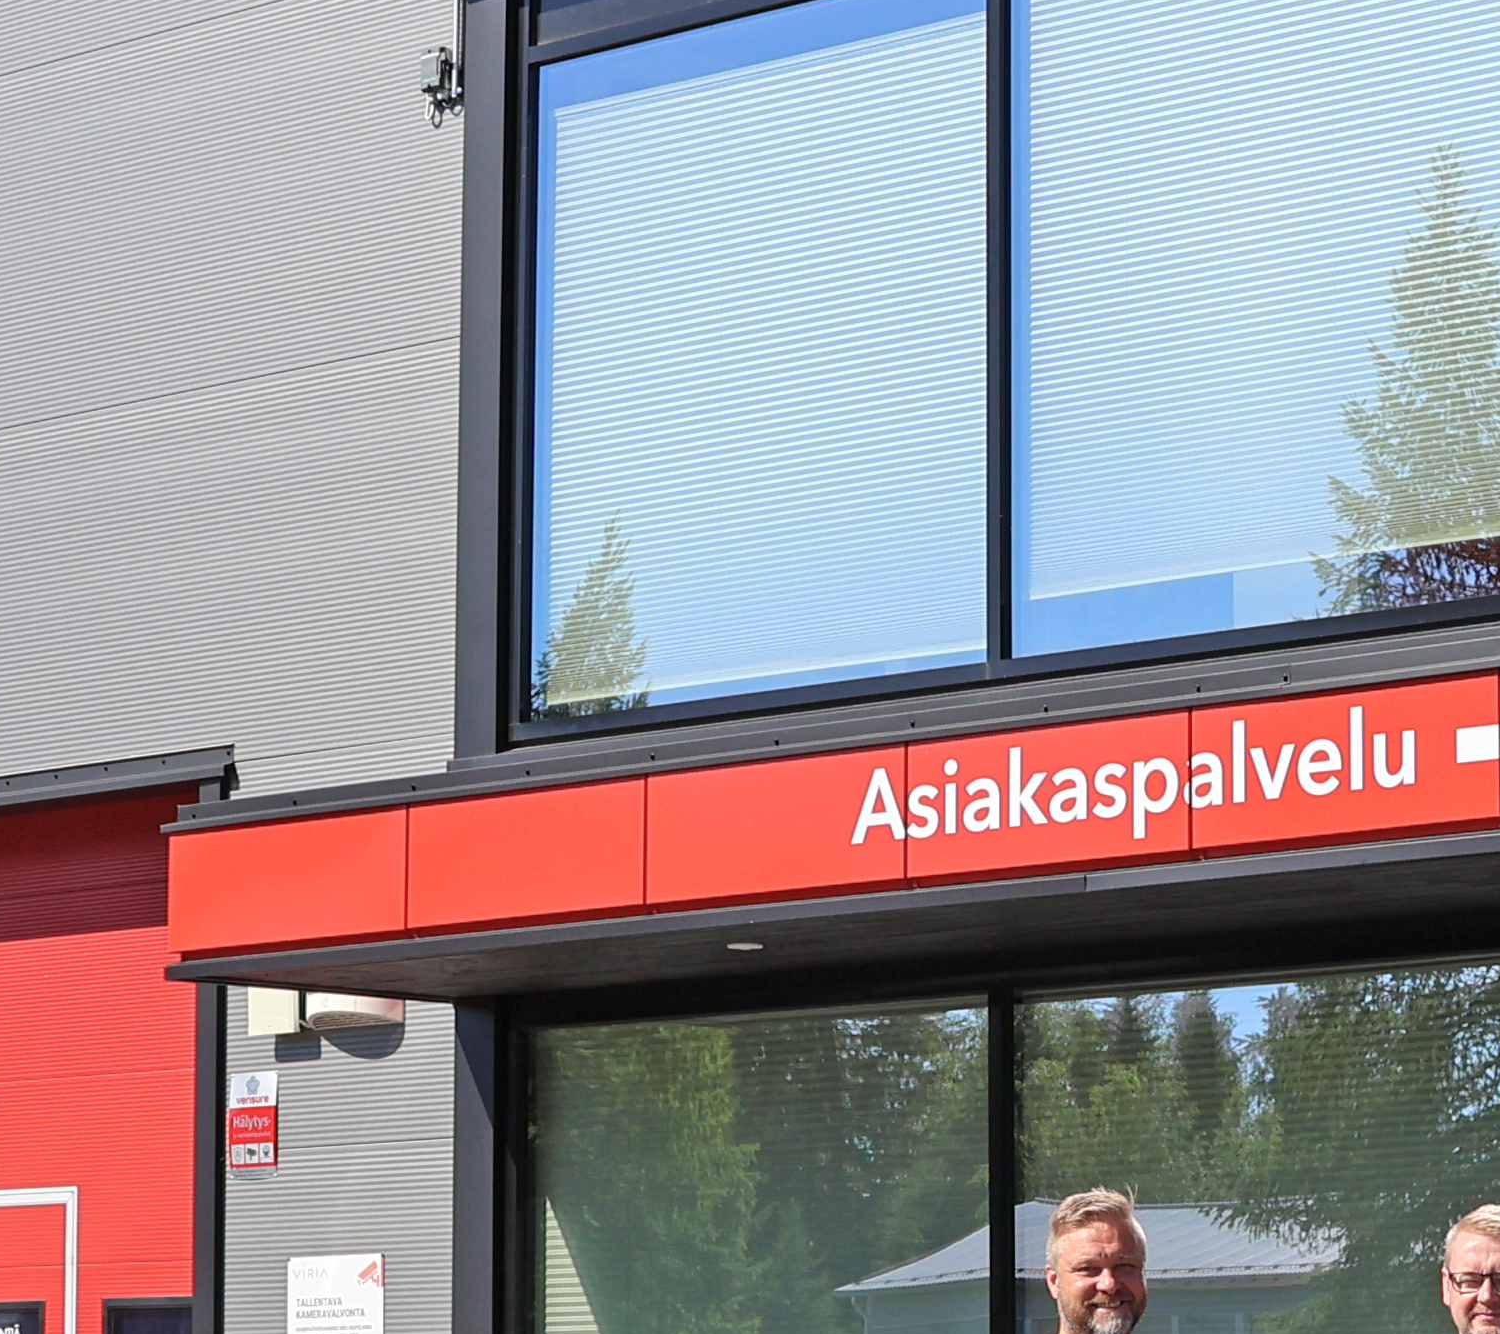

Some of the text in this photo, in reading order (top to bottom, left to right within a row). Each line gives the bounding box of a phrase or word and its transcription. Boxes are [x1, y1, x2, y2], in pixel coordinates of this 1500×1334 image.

[849, 704, 1417, 846] Asiakaspalvelu
[296, 1297, 343, 1307] TALLENTAVA
[296, 1308, 366, 1319] KAMERAVALVONTA
